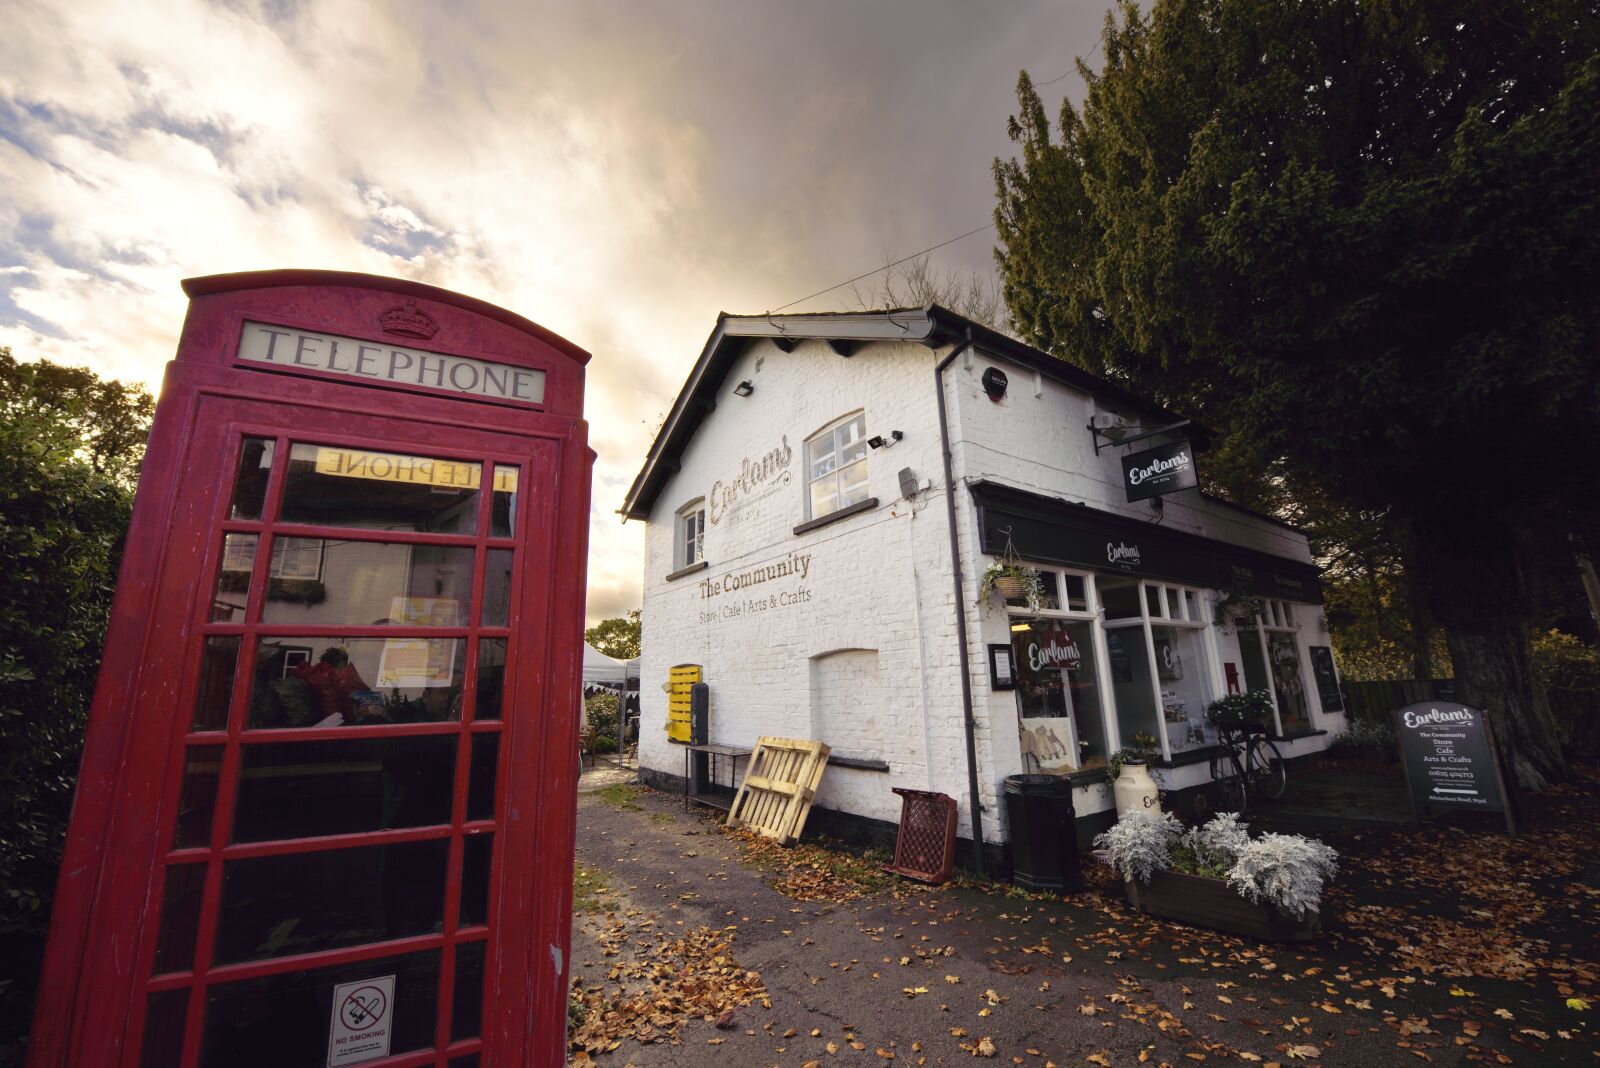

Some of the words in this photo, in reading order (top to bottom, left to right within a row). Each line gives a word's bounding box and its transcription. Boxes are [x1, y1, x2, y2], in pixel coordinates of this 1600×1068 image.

[259, 329, 533, 399] TELEPHONE
[710, 434, 792, 527] Earlams
[1129, 451, 1189, 485] Earlams
[1107, 541, 1140, 563] Earlams
[699, 578, 721, 600] The
[723, 552, 812, 592] Community
[699, 610, 717, 623] Store
[722, 602, 741, 618] Cafe
[748, 599, 767, 613] Arts
[769, 594, 777, 608] &
[780, 585, 812, 607] Crafts
[1028, 640, 1080, 672] Earlams
[1404, 708, 1474, 728] Earlams
[335, 1037, 347, 1045] NO
[349, 1029, 385, 1042] SMOKING
